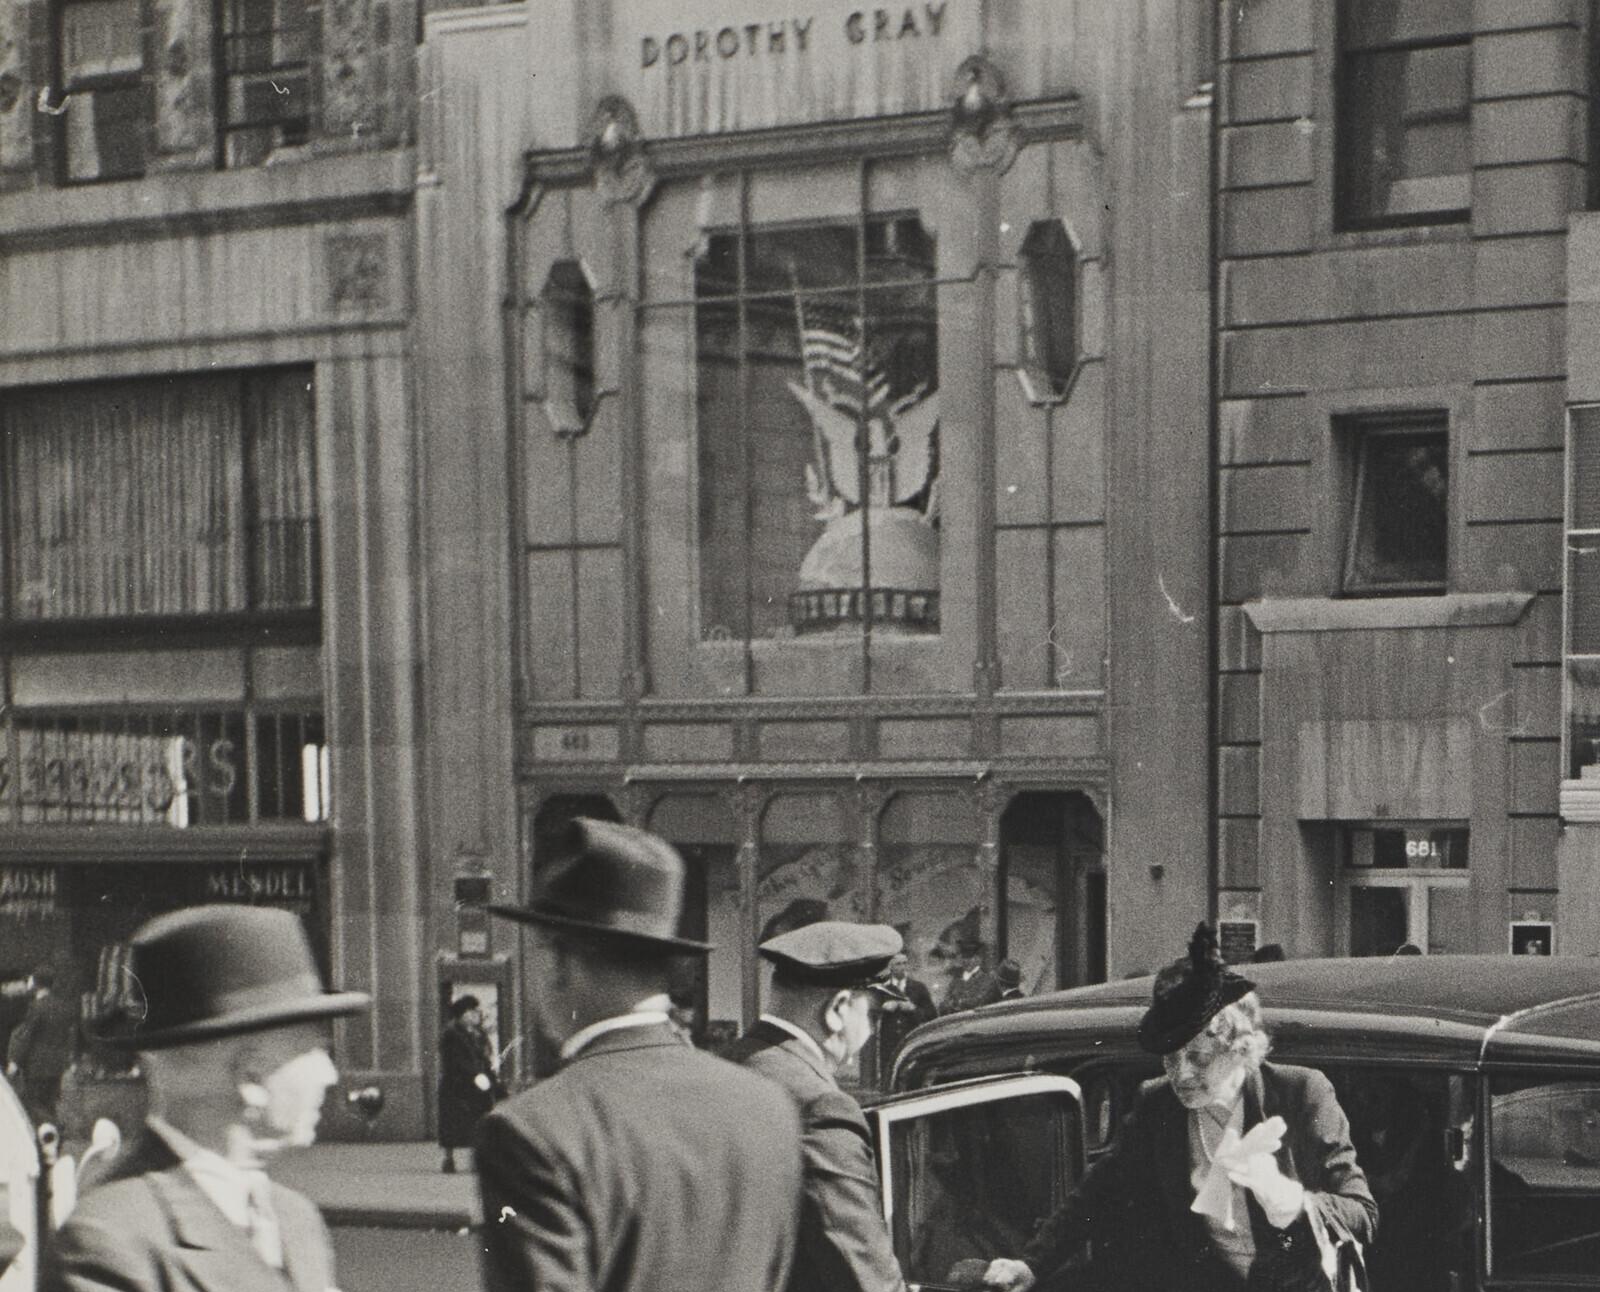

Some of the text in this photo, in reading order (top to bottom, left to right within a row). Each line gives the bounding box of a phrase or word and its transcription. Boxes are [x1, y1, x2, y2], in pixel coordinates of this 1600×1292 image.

[640, 1, 948, 69] DOROTHY GRAY
[1405, 840, 1438, 857] 681
